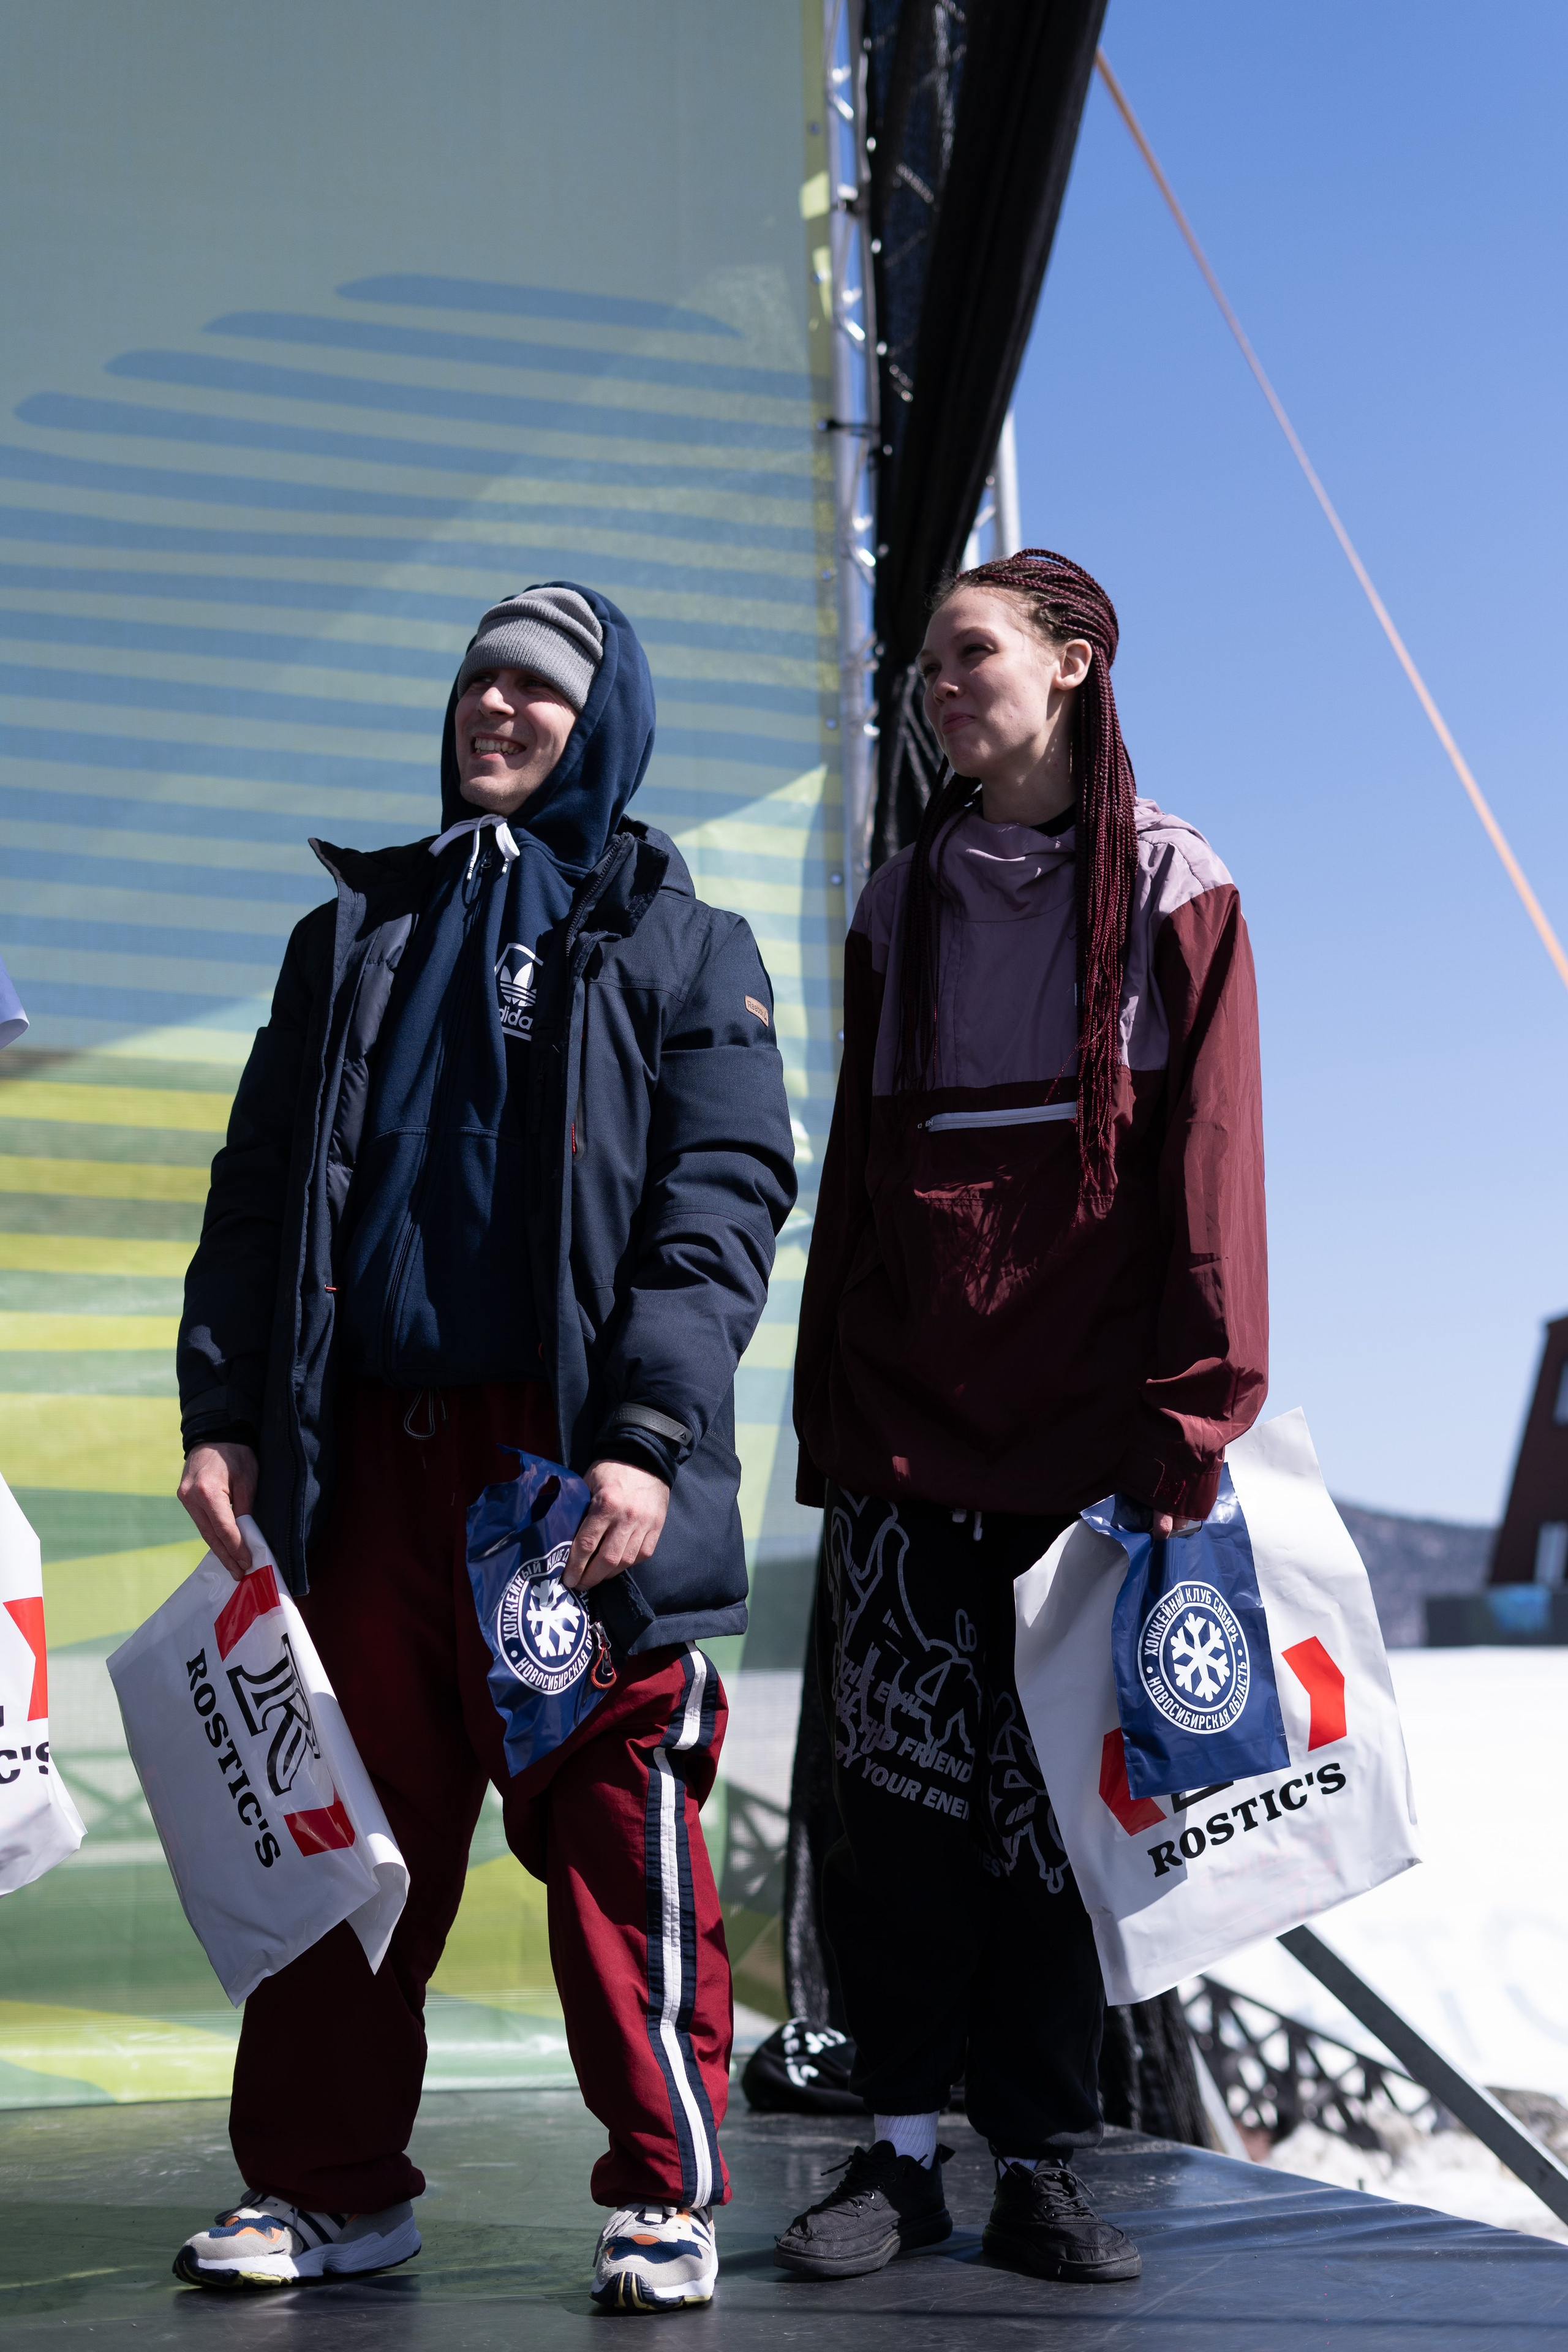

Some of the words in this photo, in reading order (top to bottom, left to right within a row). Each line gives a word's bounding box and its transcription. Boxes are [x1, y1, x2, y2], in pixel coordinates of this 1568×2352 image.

[499, 1006, 533, 1030] dida
[503, 1561, 541, 1642] ХОККЕЙНЫЙ
[547, 1550, 563, 1571] КЛУБ
[1145, 1588, 1185, 1656] ХОККЕЙНЫЙ
[1185, 1588, 1212, 1604] КЛУБ
[1213, 1597, 1239, 1643] СИБИРЬ
[515, 1649, 589, 1691] НОВОСИБИРСКАЯ
[1147, 1676, 1230, 1730] НОВОСИБИРСКАЯ
[1229, 1661, 1248, 1715] ОБЛАСТЬ
[186, 1648, 282, 1868] ROSTIC'S
[861, 1757, 922, 1801] YOUR
[897, 1736, 974, 1783] FRIEND
[1147, 1763, 1346, 1878] ROSTIC'S
